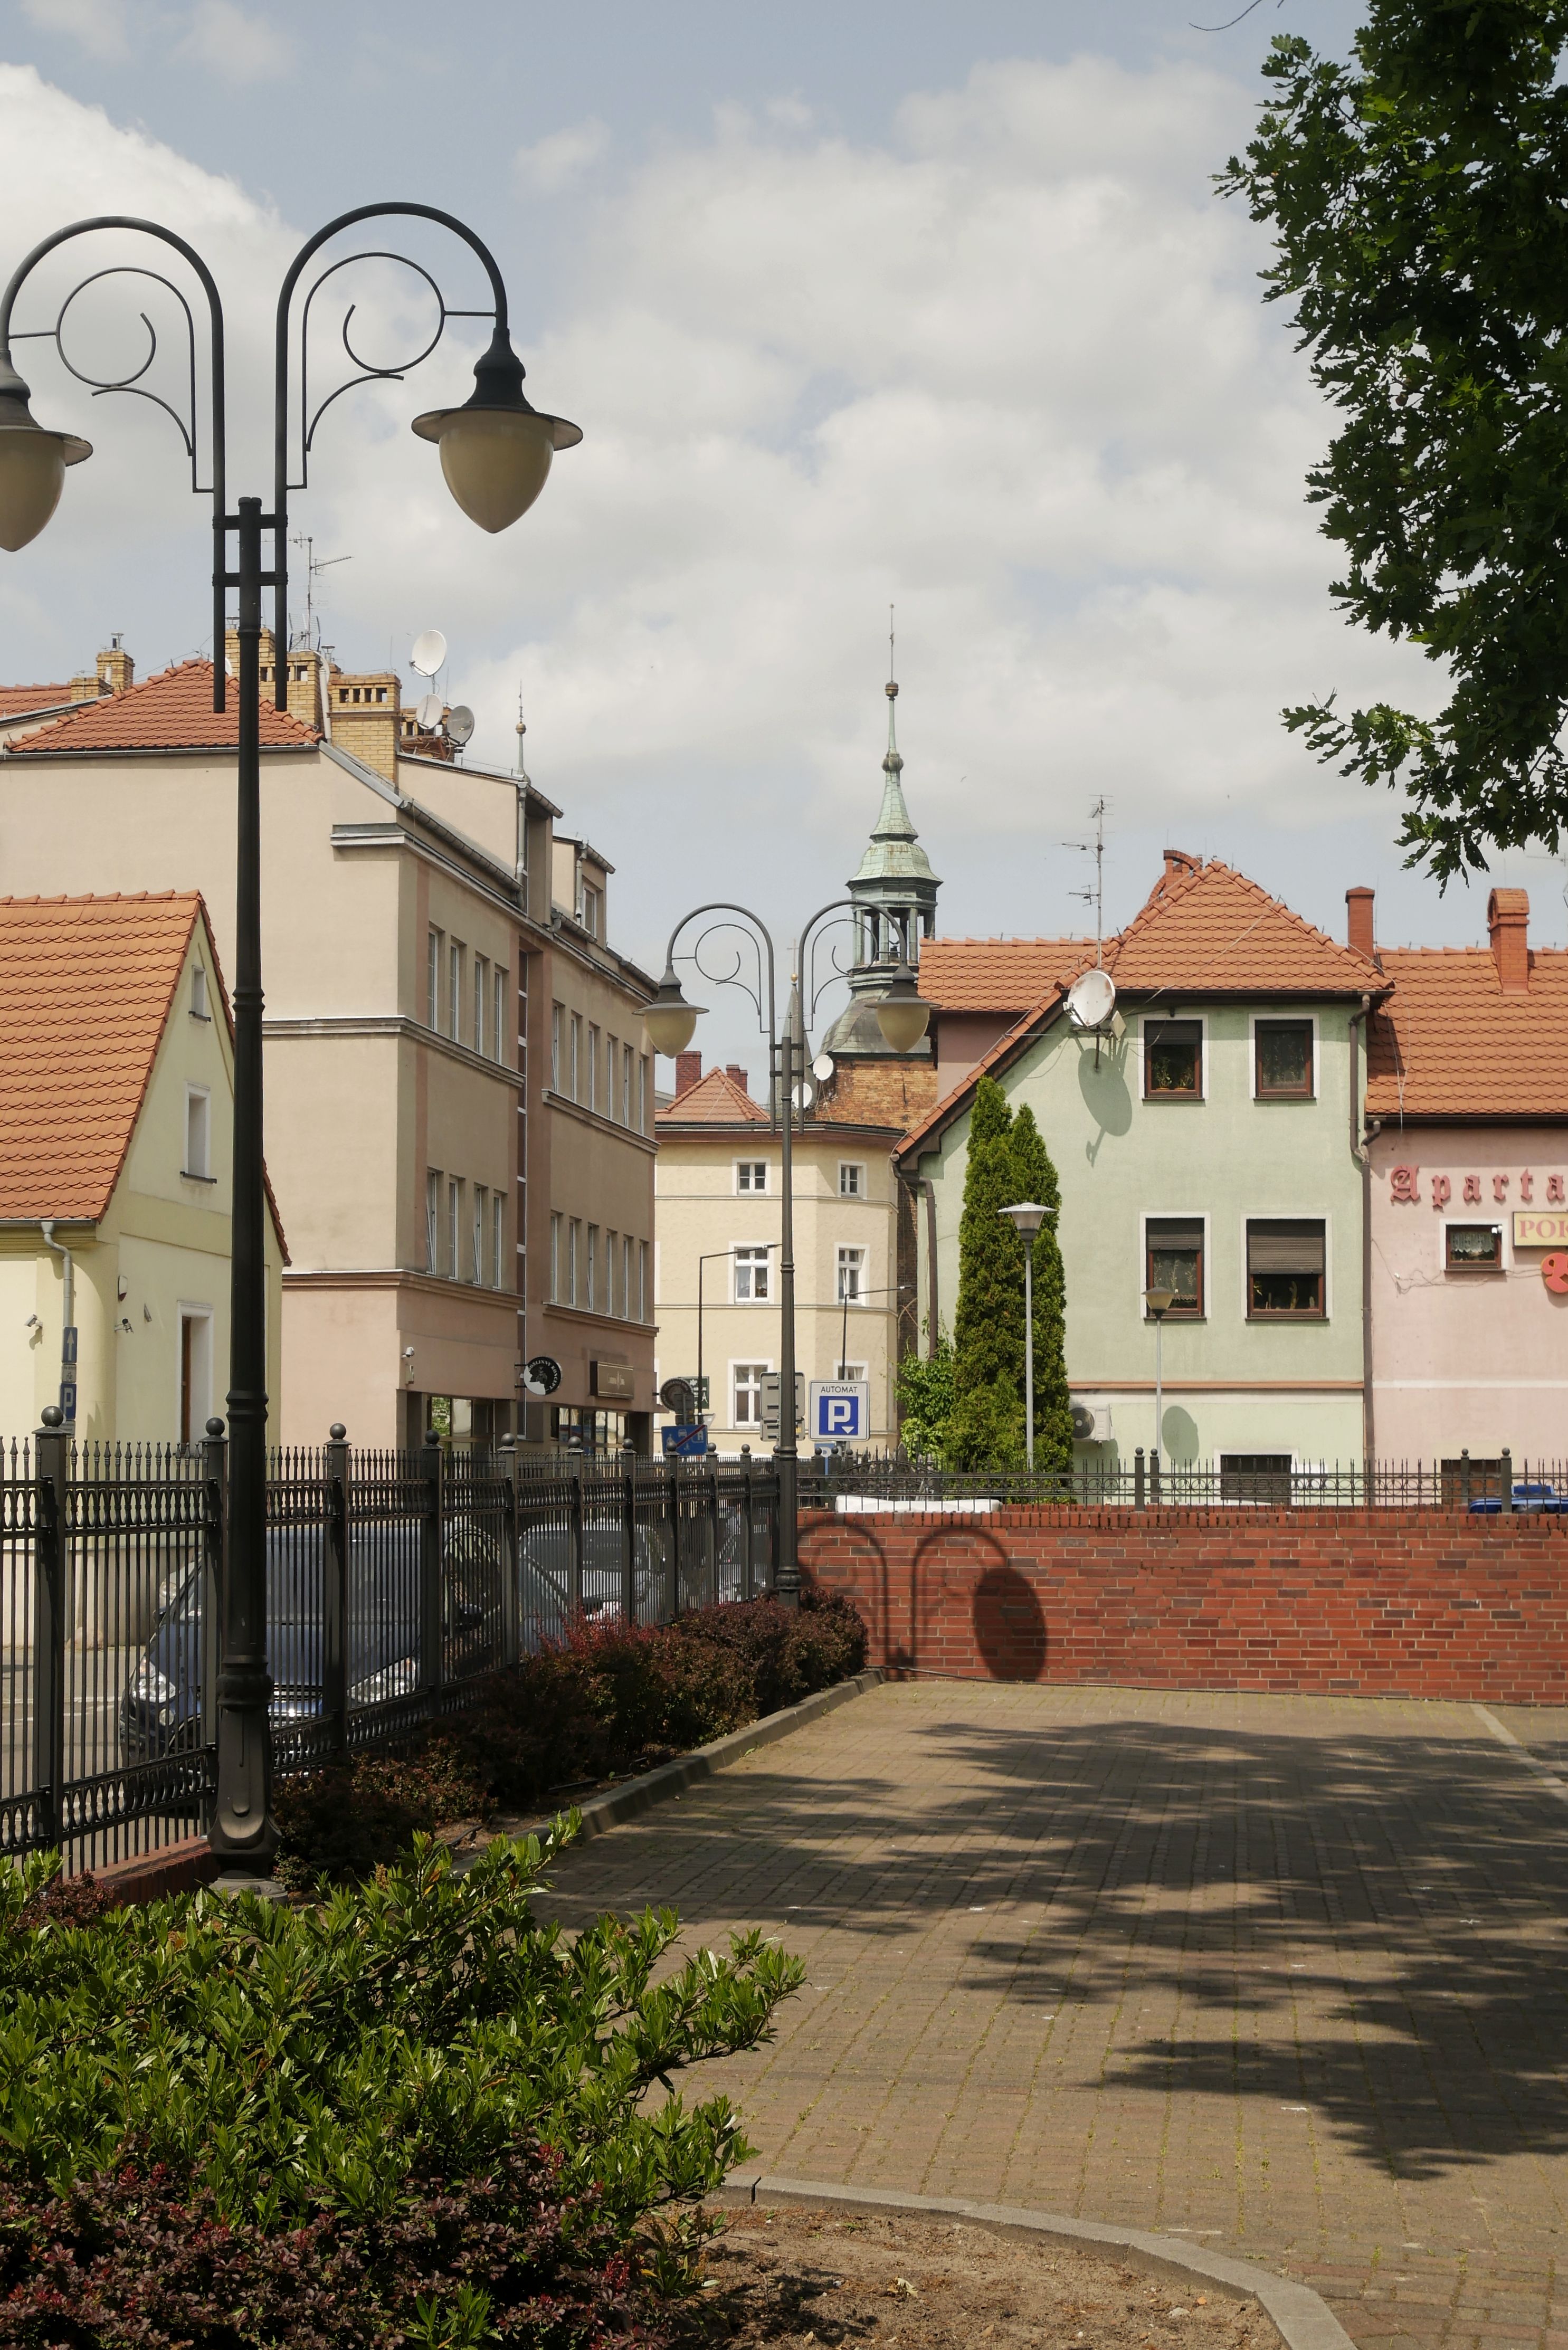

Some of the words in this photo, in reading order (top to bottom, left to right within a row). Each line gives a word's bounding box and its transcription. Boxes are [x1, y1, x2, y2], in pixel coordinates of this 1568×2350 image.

[1390, 1165, 1565, 1207] Aparta
[63, 1387, 73, 1415] P
[828, 1400, 851, 1431] P
